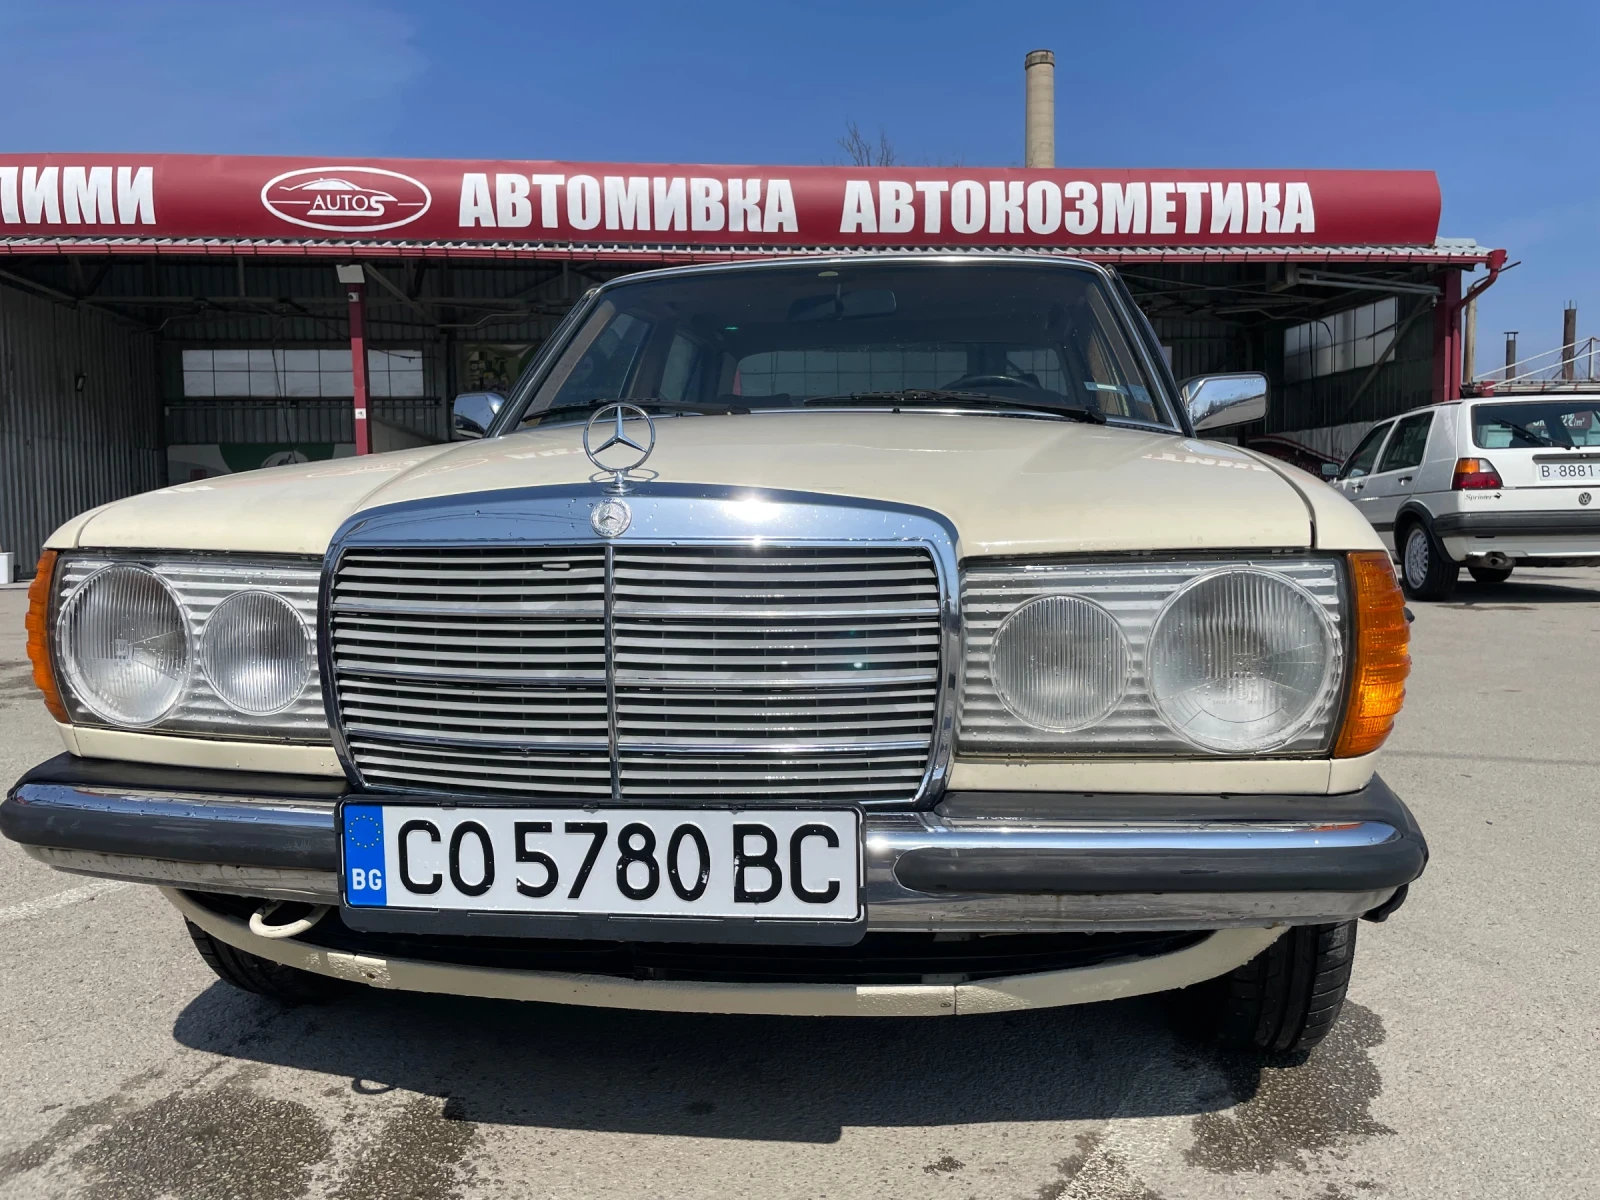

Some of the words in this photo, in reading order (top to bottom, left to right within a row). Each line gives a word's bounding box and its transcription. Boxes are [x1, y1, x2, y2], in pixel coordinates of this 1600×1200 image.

[457, 172, 799, 234] АВТОМИВКА
[840, 180, 1317, 235] АВТОКОЗМЕТИКА
[352, 868, 382, 891] BG
[398, 819, 495, 897] CO
[514, 821, 711, 903] 5780
[732, 823, 840, 904] BC
